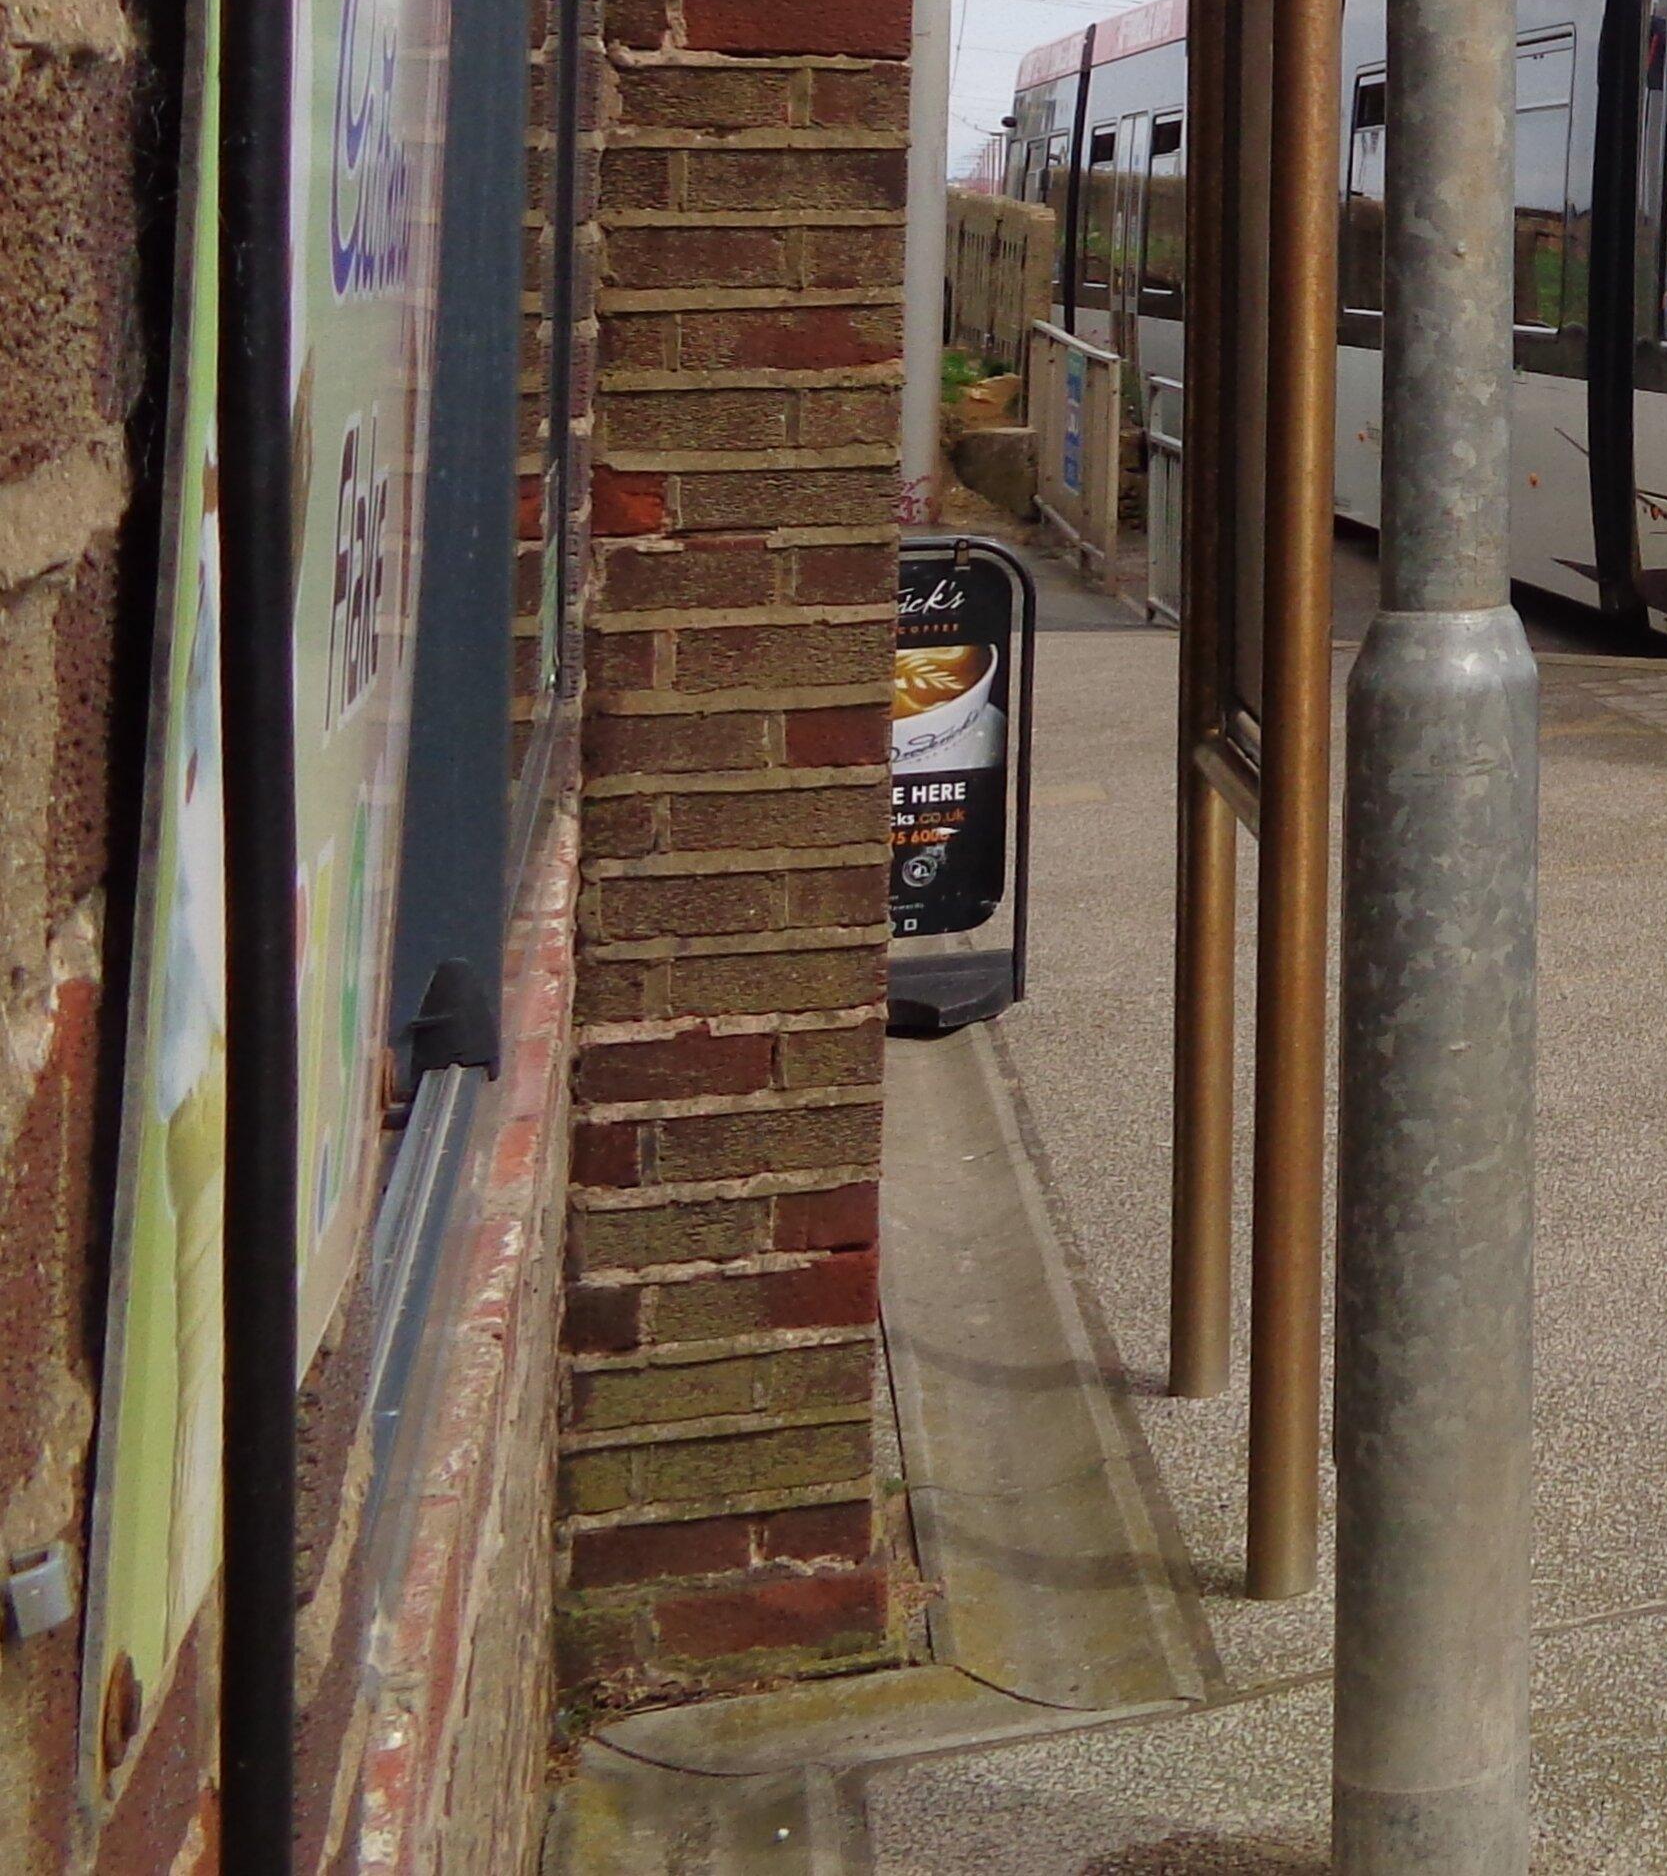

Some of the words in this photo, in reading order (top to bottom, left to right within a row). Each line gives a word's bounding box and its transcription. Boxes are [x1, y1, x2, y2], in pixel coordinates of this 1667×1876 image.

[323, 408, 388, 738] Flake
[897, 579, 966, 615] ick's
[911, 781, 967, 804] HERE
